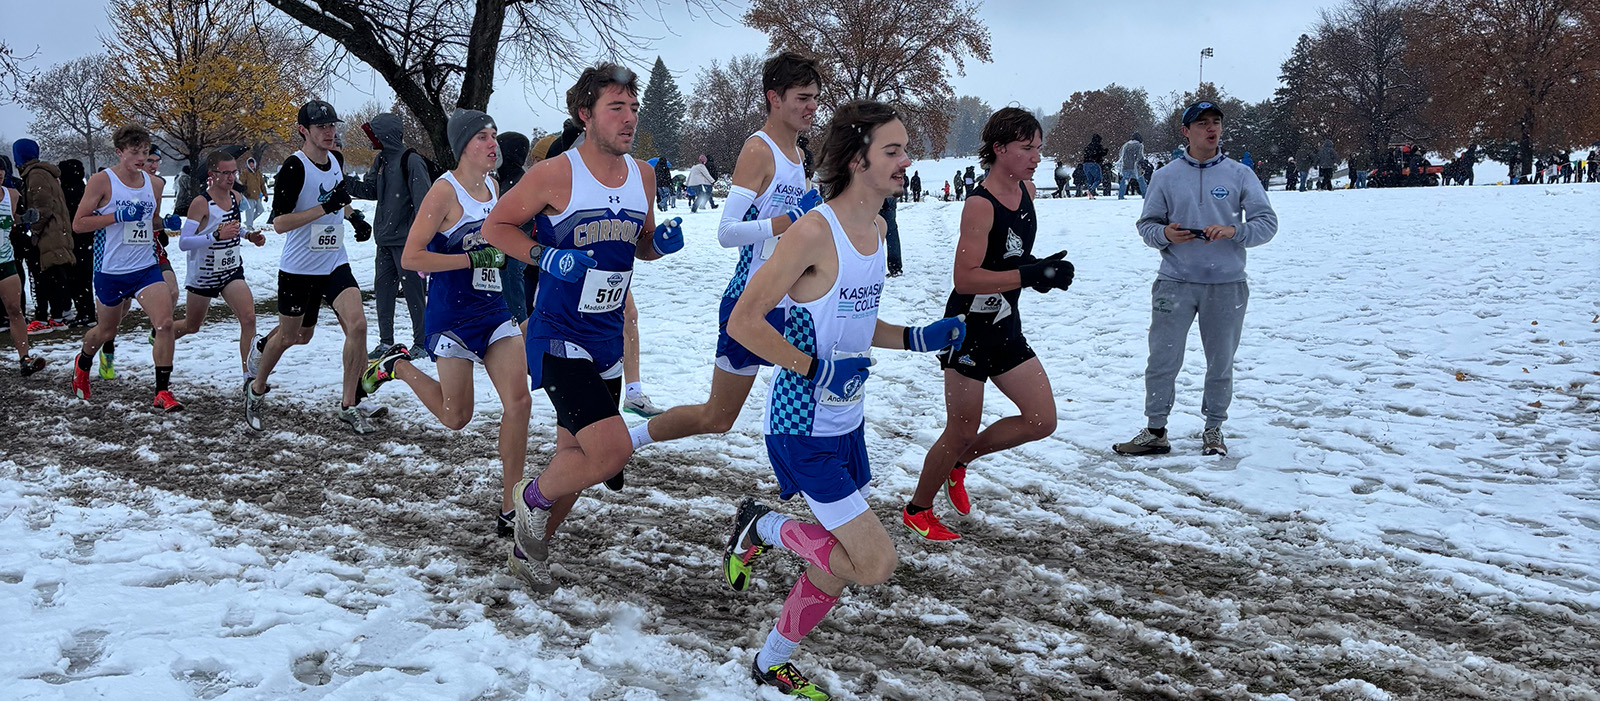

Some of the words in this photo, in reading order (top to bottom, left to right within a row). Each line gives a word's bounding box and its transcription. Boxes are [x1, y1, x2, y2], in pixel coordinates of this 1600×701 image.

[115, 200, 154, 208] KASSKIA
[132, 229, 148, 239] 741
[318, 234, 337, 246] 656
[221, 255, 236, 267] 686
[481, 268, 496, 283] 509
[595, 287, 623, 304] 510
[854, 295, 881, 312] COLLE
